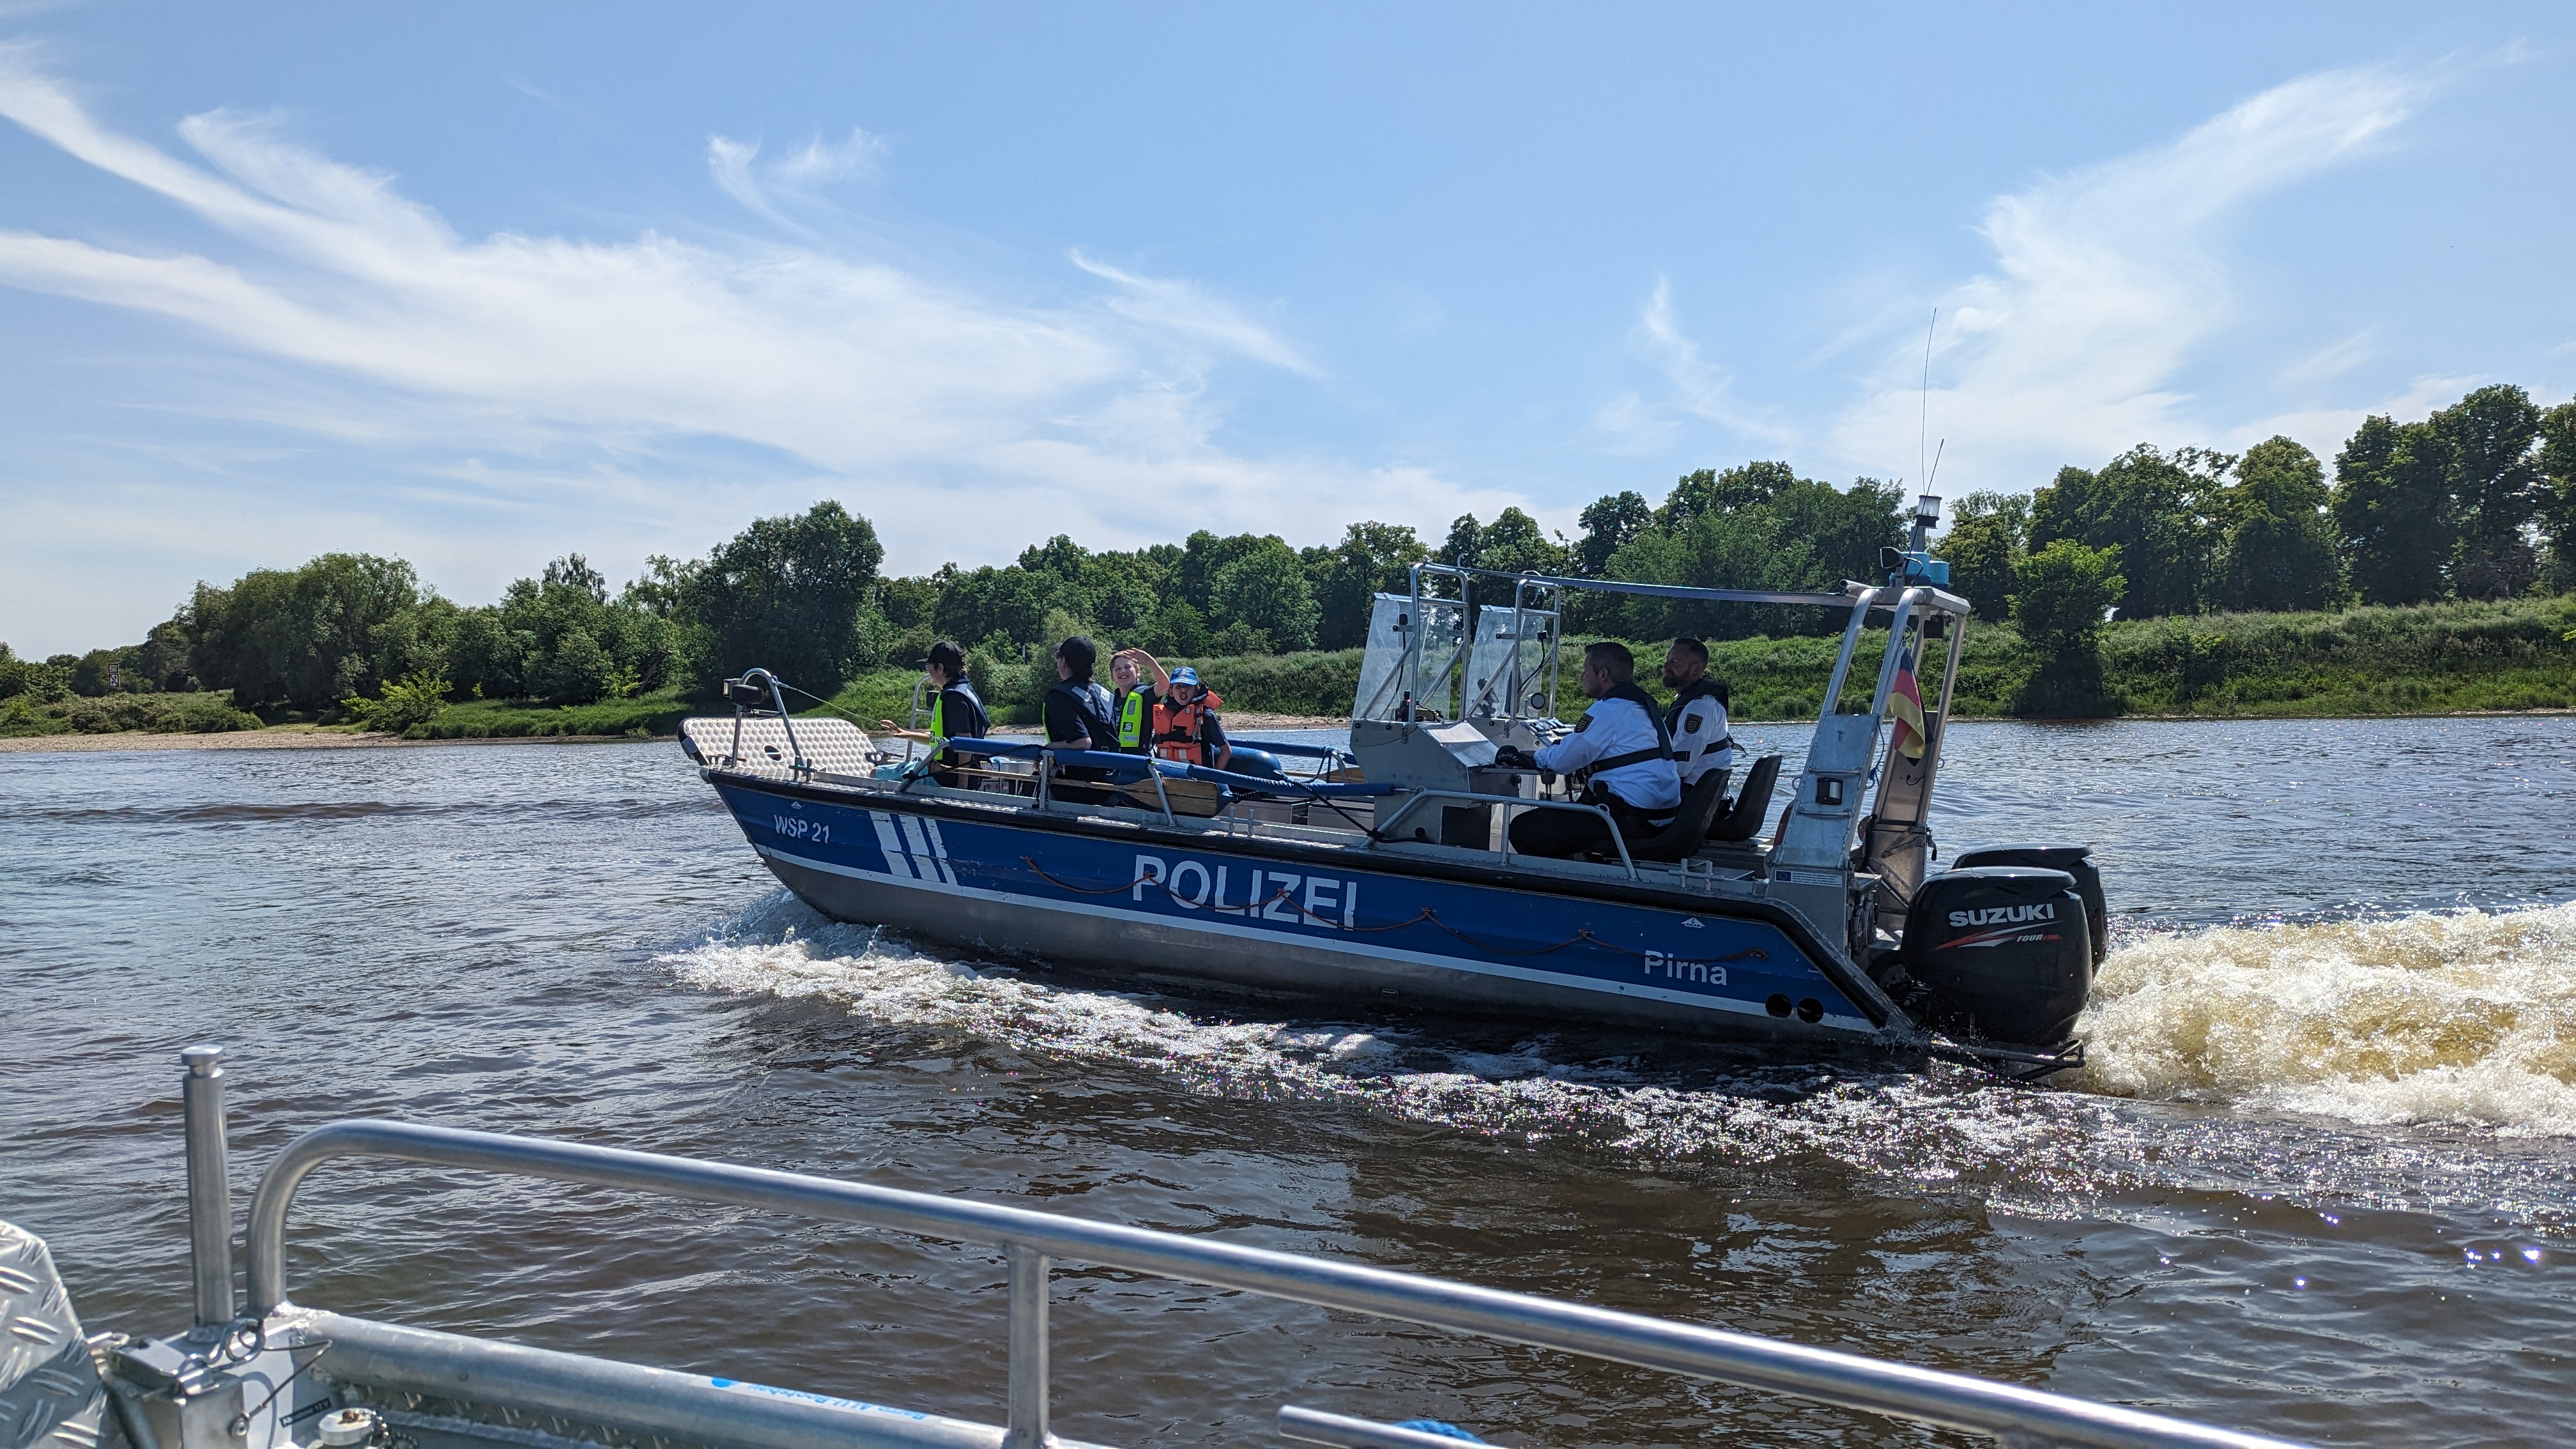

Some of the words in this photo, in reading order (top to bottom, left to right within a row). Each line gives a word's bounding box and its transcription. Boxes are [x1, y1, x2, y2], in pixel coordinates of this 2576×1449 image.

[774, 815, 808, 838] WSP
[811, 822, 829, 843] 21
[1133, 854, 1357, 931] POLIZEI
[1949, 903, 2055, 927] SUZUKI
[1644, 949, 1728, 986] Pirna
